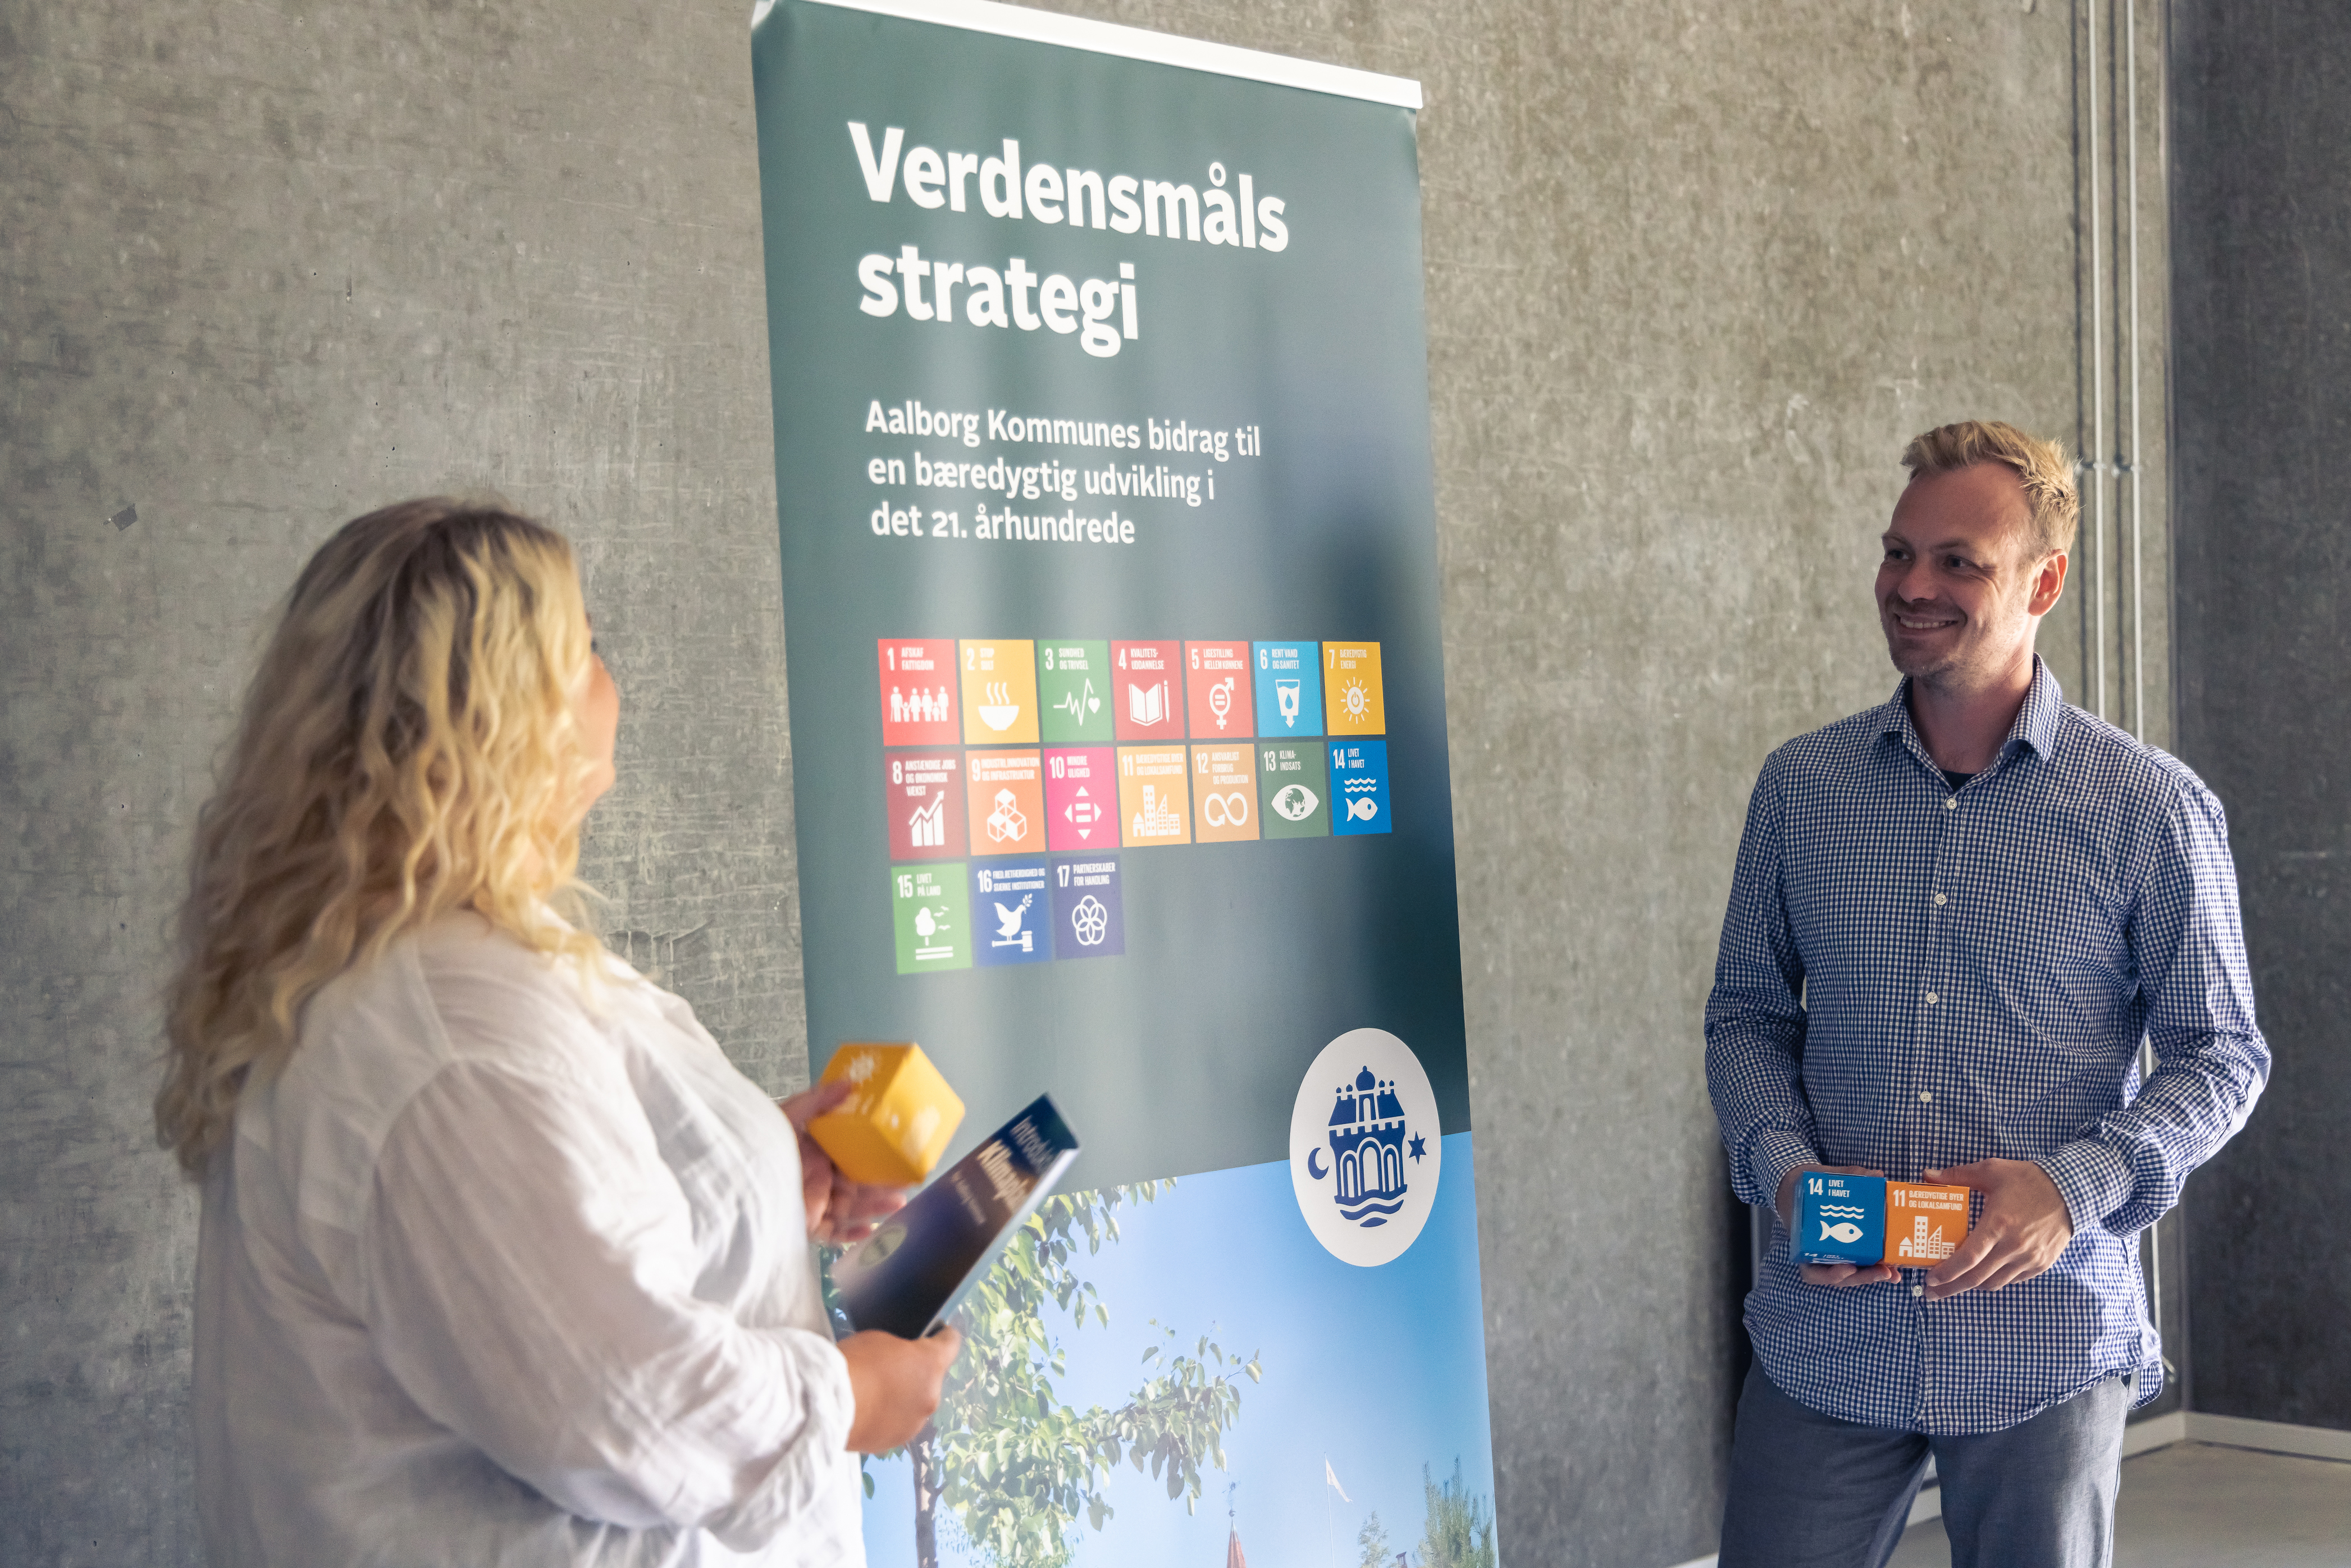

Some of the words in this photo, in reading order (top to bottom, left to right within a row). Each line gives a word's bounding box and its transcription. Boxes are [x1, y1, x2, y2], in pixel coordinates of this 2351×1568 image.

[848, 121, 1289, 252] Verdensmåls
[858, 245, 1139, 358] strategi
[866, 401, 980, 447] Aalborg
[988, 409, 1140, 449] Kommunes
[1148, 418, 1229, 461] bidrag
[1235, 426, 1261, 456] til
[869, 458, 905, 484] en
[915, 452, 1077, 501] bæredygtig
[1085, 463, 1200, 507] udvikling
[1208, 470, 1215, 500] i
[871, 501, 923, 536] det
[932, 511, 967, 538] 21.
[975, 504, 1135, 543] århundrede
[902, 647, 923, 657] AFSKAF
[980, 648, 994, 658] STOP
[1059, 648, 1084, 657] SUNDHED
[1131, 648, 1158, 657] KVALITETS-
[1203, 649, 1232, 658] LIGESTILLING
[1272, 649, 1284, 658] RENT
[1284, 649, 1298, 658] VAND
[1340, 649, 1367, 658] BÆREDYGTIG
[888, 648, 894, 670] 1
[967, 648, 975, 670] 2
[1045, 648, 1054, 670] 3
[1119, 648, 1126, 670] 4
[1191, 649, 1199, 669] 5
[1260, 649, 1268, 669] 6
[1329, 650, 1335, 669] 7
[902, 660, 934, 670] FATTIGDOM
[981, 661, 993, 670] SULT
[1060, 660, 1067, 670] OG
[1067, 660, 1089, 670] TRIVSEL
[1131, 660, 1164, 670] UDDANNELSE
[1204, 660, 1222, 669] MELLEM
[1222, 660, 1243, 669] KØNNENE
[1272, 661, 1280, 669] OG
[1280, 660, 1299, 669] SANITET
[1340, 660, 1356, 669] ENERGI
[1212, 752, 1239, 761] ANSVARLIGT
[1279, 750, 1296, 759] KLIMA-
[1348, 748, 1359, 757] LIVET
[1067, 756, 1087, 765] MINDRE
[1196, 753, 1208, 774] 12
[1264, 751, 1276, 771] 13
[1333, 749, 1345, 769] 14
[1349, 760, 1350, 769] I
[1350, 759, 1364, 768] HAVET
[905, 760, 941, 771] ANSTÆNDIGE
[942, 760, 956, 770] JOBS
[971, 759, 981, 781] 9
[1050, 756, 1065, 779] 10
[1122, 755, 1133, 776] 11
[1136, 766, 1144, 775] OG
[1144, 765, 1182, 775] LOKALSAMFUND
[1212, 763, 1233, 773] FORBRUG
[1280, 761, 1300, 770] INDSATS
[893, 761, 903, 784] 8
[982, 771, 990, 781] OG
[1068, 768, 1090, 778] ULIGHED
[906, 774, 915, 784] OG
[1213, 776, 1220, 784] OG
[1220, 775, 1248, 784] PRODUKTION
[906, 785, 926, 796] VÆKST
[1038, 868, 1045, 876] OG
[1073, 862, 1115, 874] PARTNERSKABER
[916, 873, 932, 884] LIVET
[978, 870, 992, 893] 16
[1057, 865, 1070, 888] 17
[1074, 877, 1084, 886] FOR
[1085, 875, 1110, 885] HANDLING
[898, 874, 912, 898] 15
[926, 885, 941, 896] LAND
[1012, 881, 1044, 890] INSTITUTIONER
[1808, 1178, 1823, 1195] 14
[1832, 1189, 1850, 1197] HAVET
[1893, 1190, 1905, 1206] 11
[1909, 1190, 1948, 1200] BÆREDYGTIGE
[1918, 1200, 1962, 1210] LOKALSAMFUND
